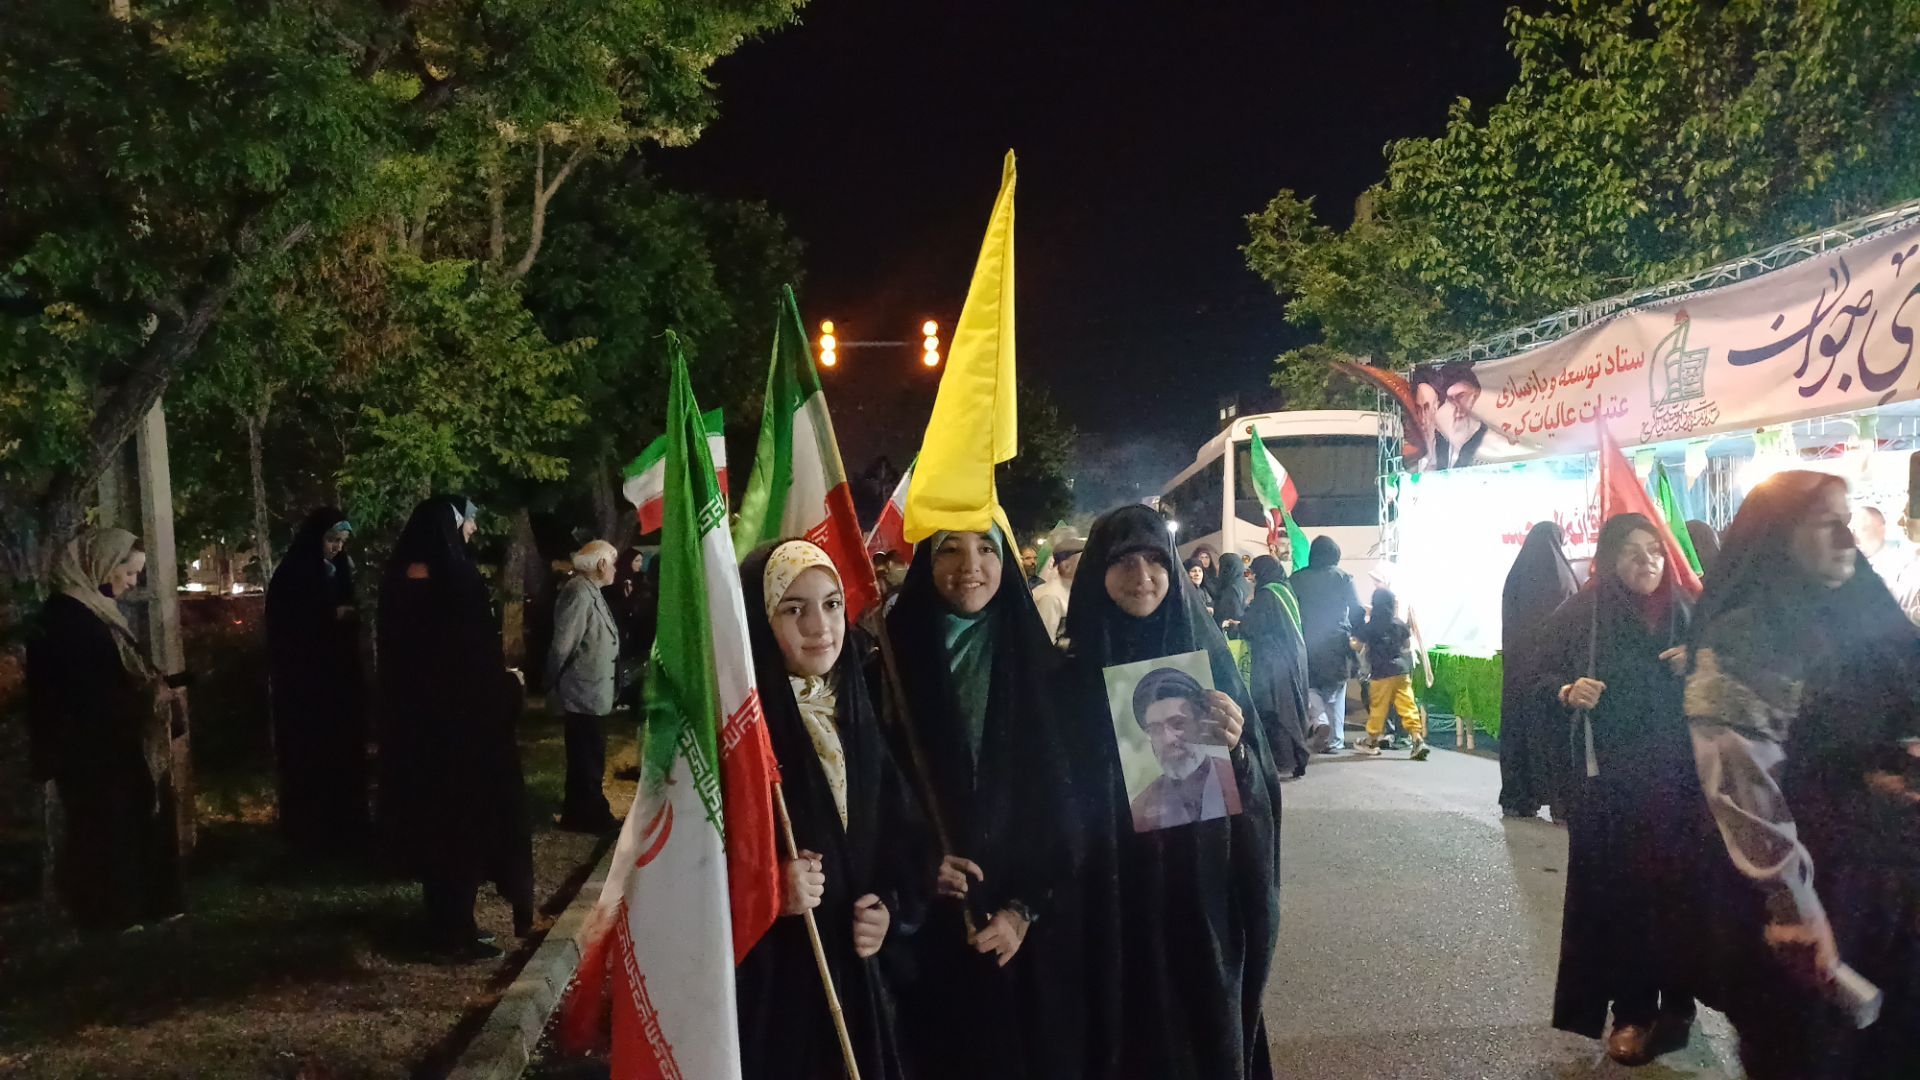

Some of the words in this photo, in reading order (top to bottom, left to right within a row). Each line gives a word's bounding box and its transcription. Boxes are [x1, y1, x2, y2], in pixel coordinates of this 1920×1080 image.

[1558, 353, 1602, 389] توسعه
[1604, 344, 1645, 375] ستاد
[1528, 401, 1577, 438] عالیات
